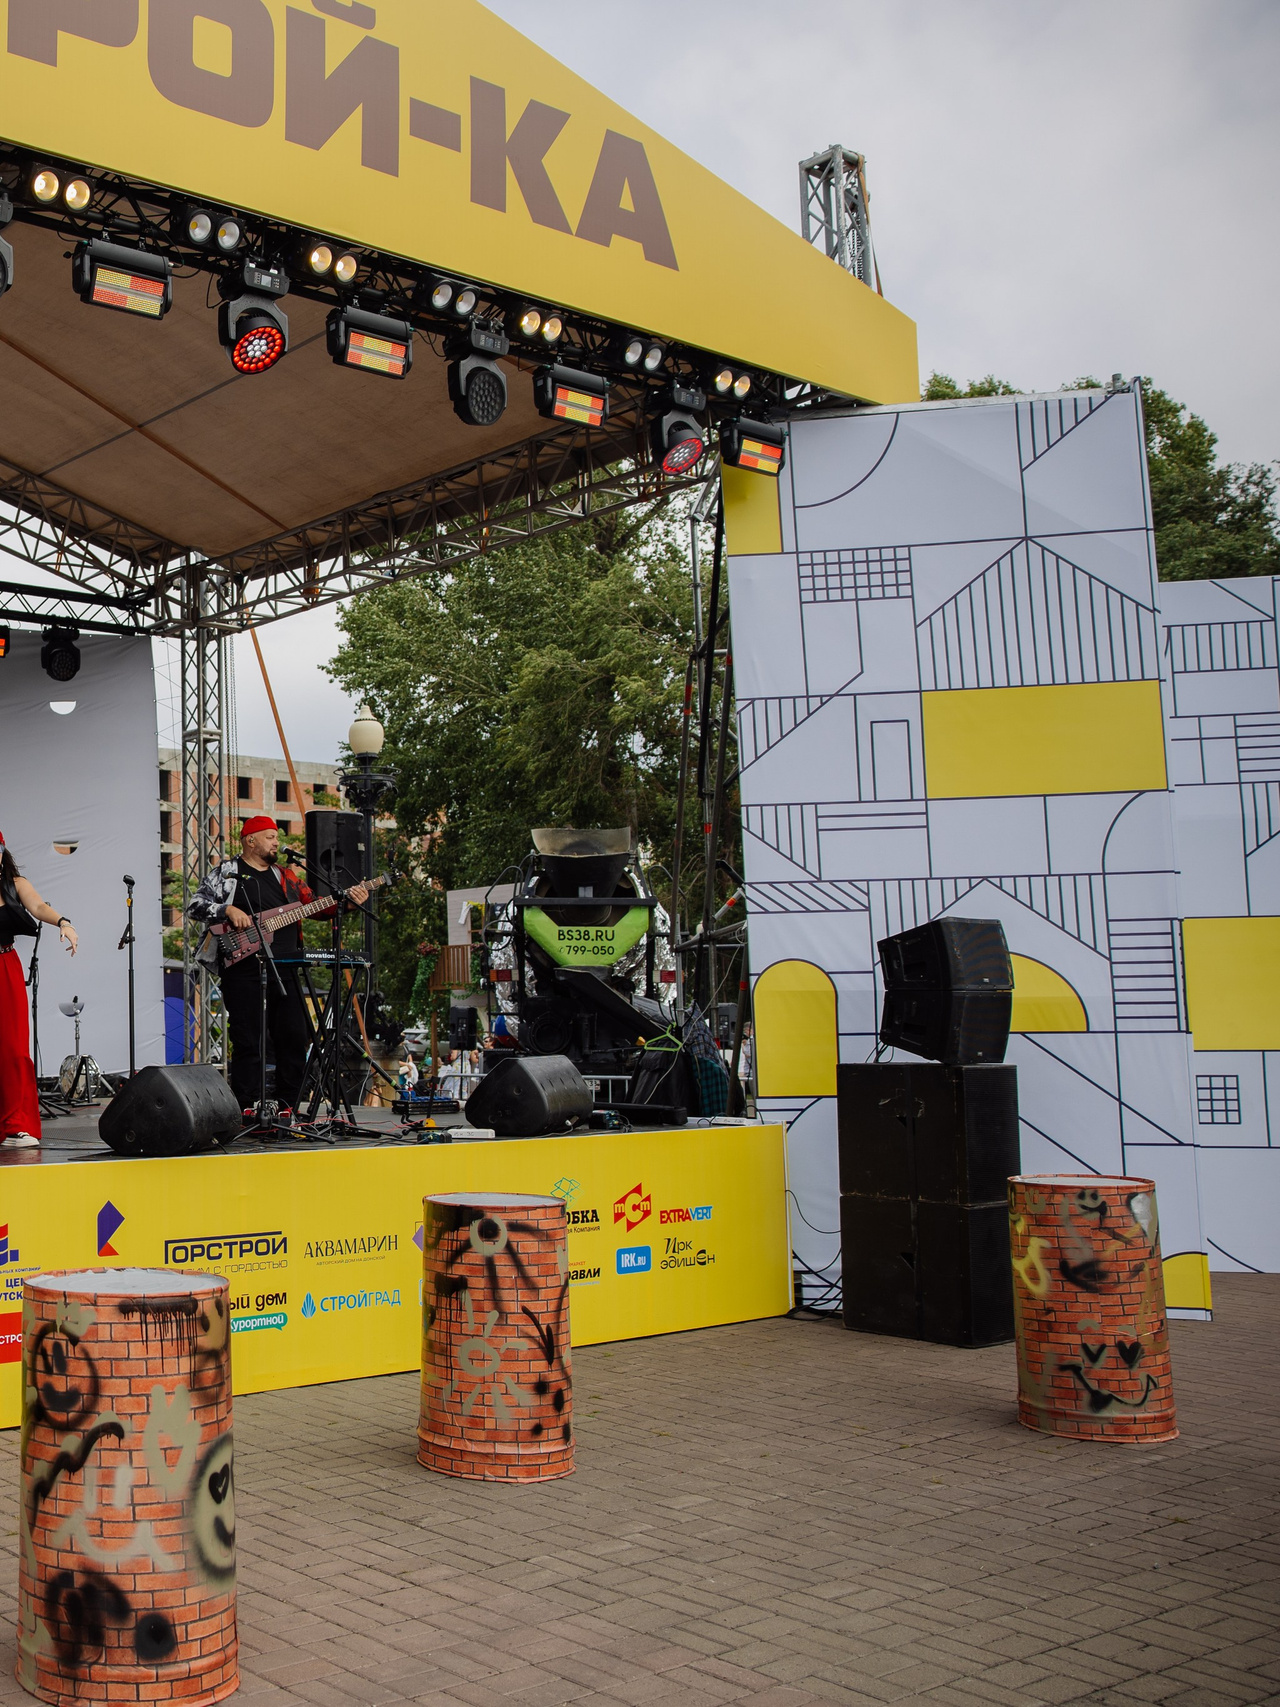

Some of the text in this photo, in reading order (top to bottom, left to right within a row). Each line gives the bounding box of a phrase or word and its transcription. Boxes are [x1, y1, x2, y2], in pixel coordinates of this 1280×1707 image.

[557, 929, 615, 941] BS38.RU
[565, 945, 615, 955] 799-050
[659, 1205, 713, 1225] EXTRAVERT
[574, 1225, 601, 1234] Компания
[303, 1234, 398, 1259] АКВАМАРИН
[664, 1237, 693, 1254] Ирк
[224, 1259, 288, 1273] ГОРДОСТЬЮ
[621, 1252, 647, 1268] IRK.RU
[230, 1291, 287, 1311] ый дом
[320, 1289, 402, 1312] СТРОЙГРАД
